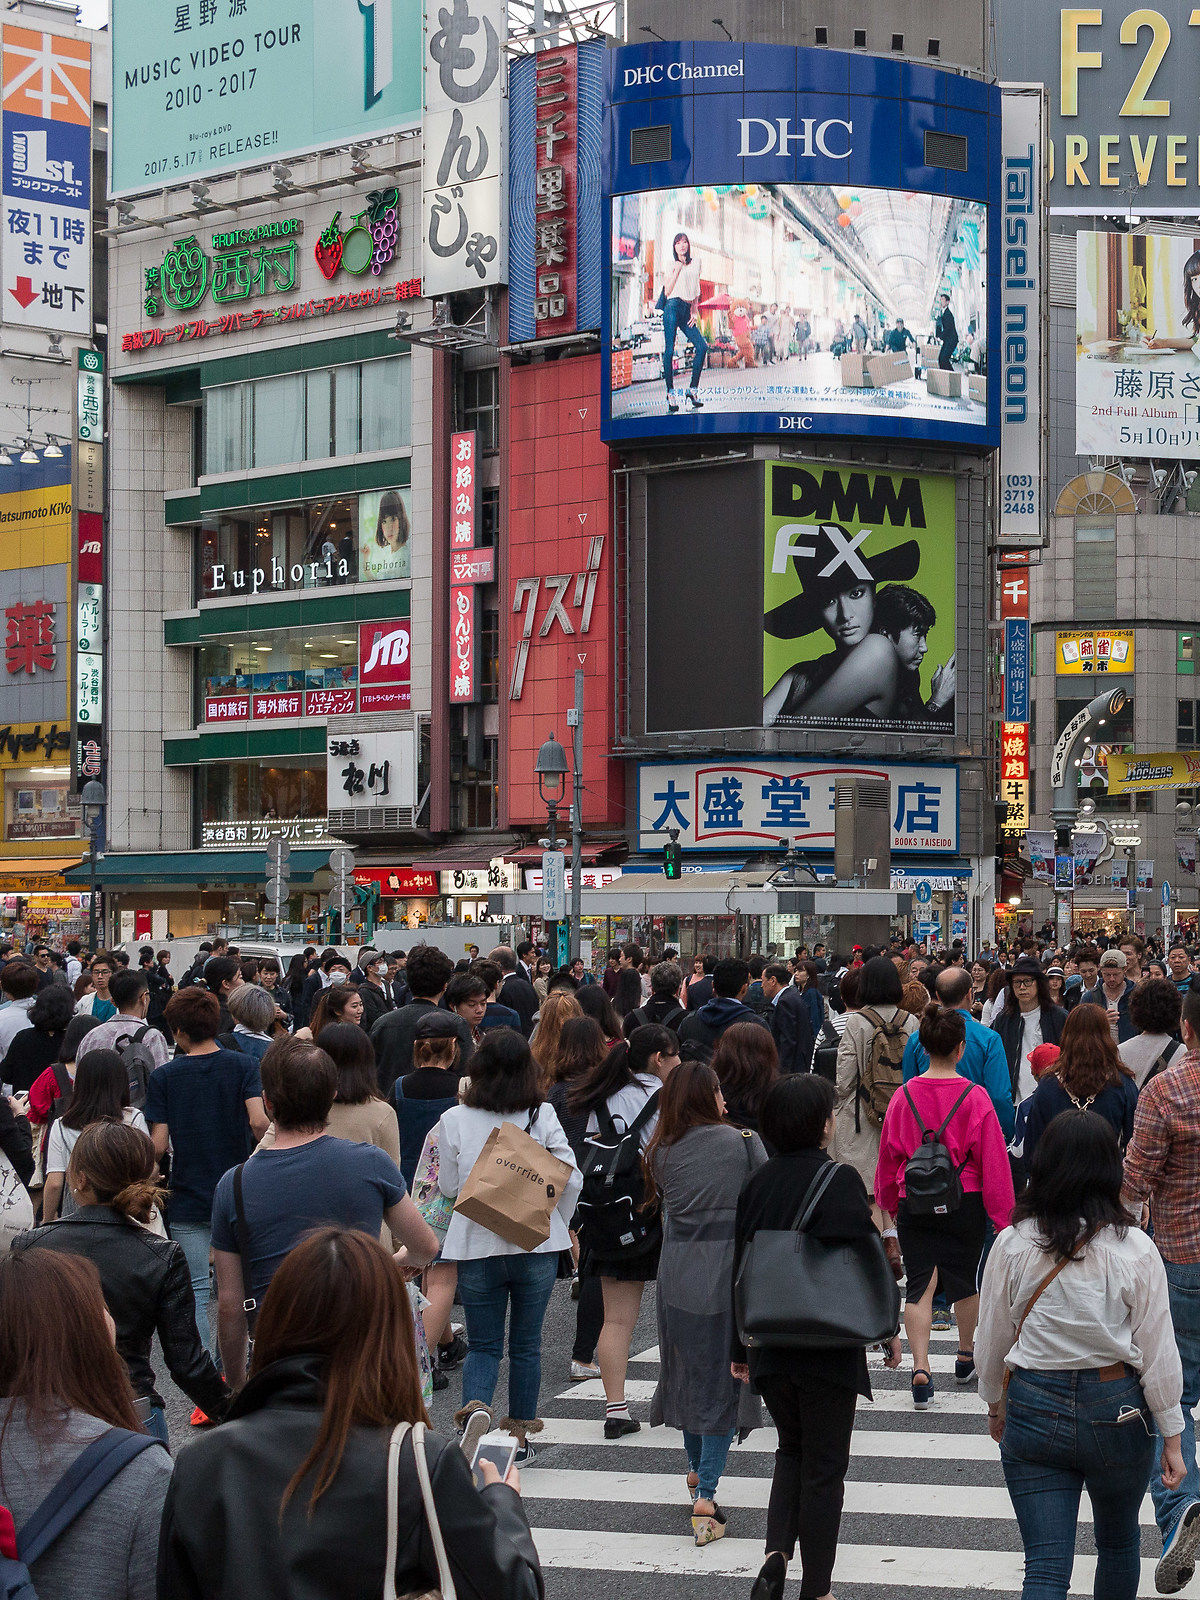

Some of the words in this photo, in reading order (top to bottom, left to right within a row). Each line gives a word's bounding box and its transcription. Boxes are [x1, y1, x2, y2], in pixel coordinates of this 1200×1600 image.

[125, 55, 181, 90] MUSIC
[190, 41, 245, 69] VIDEO
[254, 23, 301, 54] TOUR
[624, 66, 662, 87] DHC
[667, 59, 745, 81] Channel
[165, 85, 202, 112] 2010
[220, 68, 258, 97] 2017
[13, 131, 27, 170] BOOK
[144, 151, 196, 176] 2017.5.17
[209, 130, 278, 160] RELEASE!!
[736, 117, 854, 159] DHC
[11, 177, 83, 198] ブックファースト
[534, 56, 568, 321] 三千里薬品
[8, 209, 86, 246] 夜11時
[1003, 143, 1036, 292] Taisei
[23, 240, 69, 270] まで
[212, 240, 298, 304] 西村
[42, 283, 85, 312] 地下
[145, 267, 159, 317] 渋谷
[1004, 303, 1029, 424] neon
[779, 416, 813, 430] DHC
[1091, 405, 1113, 418] 2nd
[1116, 406, 1137, 419] Full
[1141, 406, 1178, 420] Album
[455, 438, 472, 543] お好み焼
[771, 464, 927, 529] DMM
[1004, 490, 1035, 501] 3719
[1006, 475, 1032, 488] (03)
[0, 506, 47, 523] atsumoto
[1003, 503, 1035, 514] 2468
[80, 540, 101, 554] JTB
[771, 523, 875, 581] FX
[210, 557, 350, 595] Euphoria
[365, 557, 407, 573] Euphoria
[91, 598, 99, 632] フルーツ
[5, 600, 57, 675] 薬
[363, 629, 410, 674] JTB
[454, 591, 472, 697] もんじゃ焼
[1081, 640, 1110, 655] 麻雀
[1010, 624, 1026, 717] 大盛堂商事ビル
[80, 672, 89, 707] フルーツ
[257, 698, 299, 715] 海外旅行
[311, 691, 351, 703] ハネムーン
[208, 702, 248, 718] 国内旅行
[308, 701, 354, 717] ウエディング
[82, 740, 101, 776] HUB
[1052, 712, 1087, 785] 渋谷センター街
[652, 777, 942, 834] 大盛堂店
[206, 825, 248, 841] 渋谷西村
[894, 837, 919, 847] BOOKS
[920, 838, 952, 848] TAISEIDO
[496, 1157, 545, 1185] override
